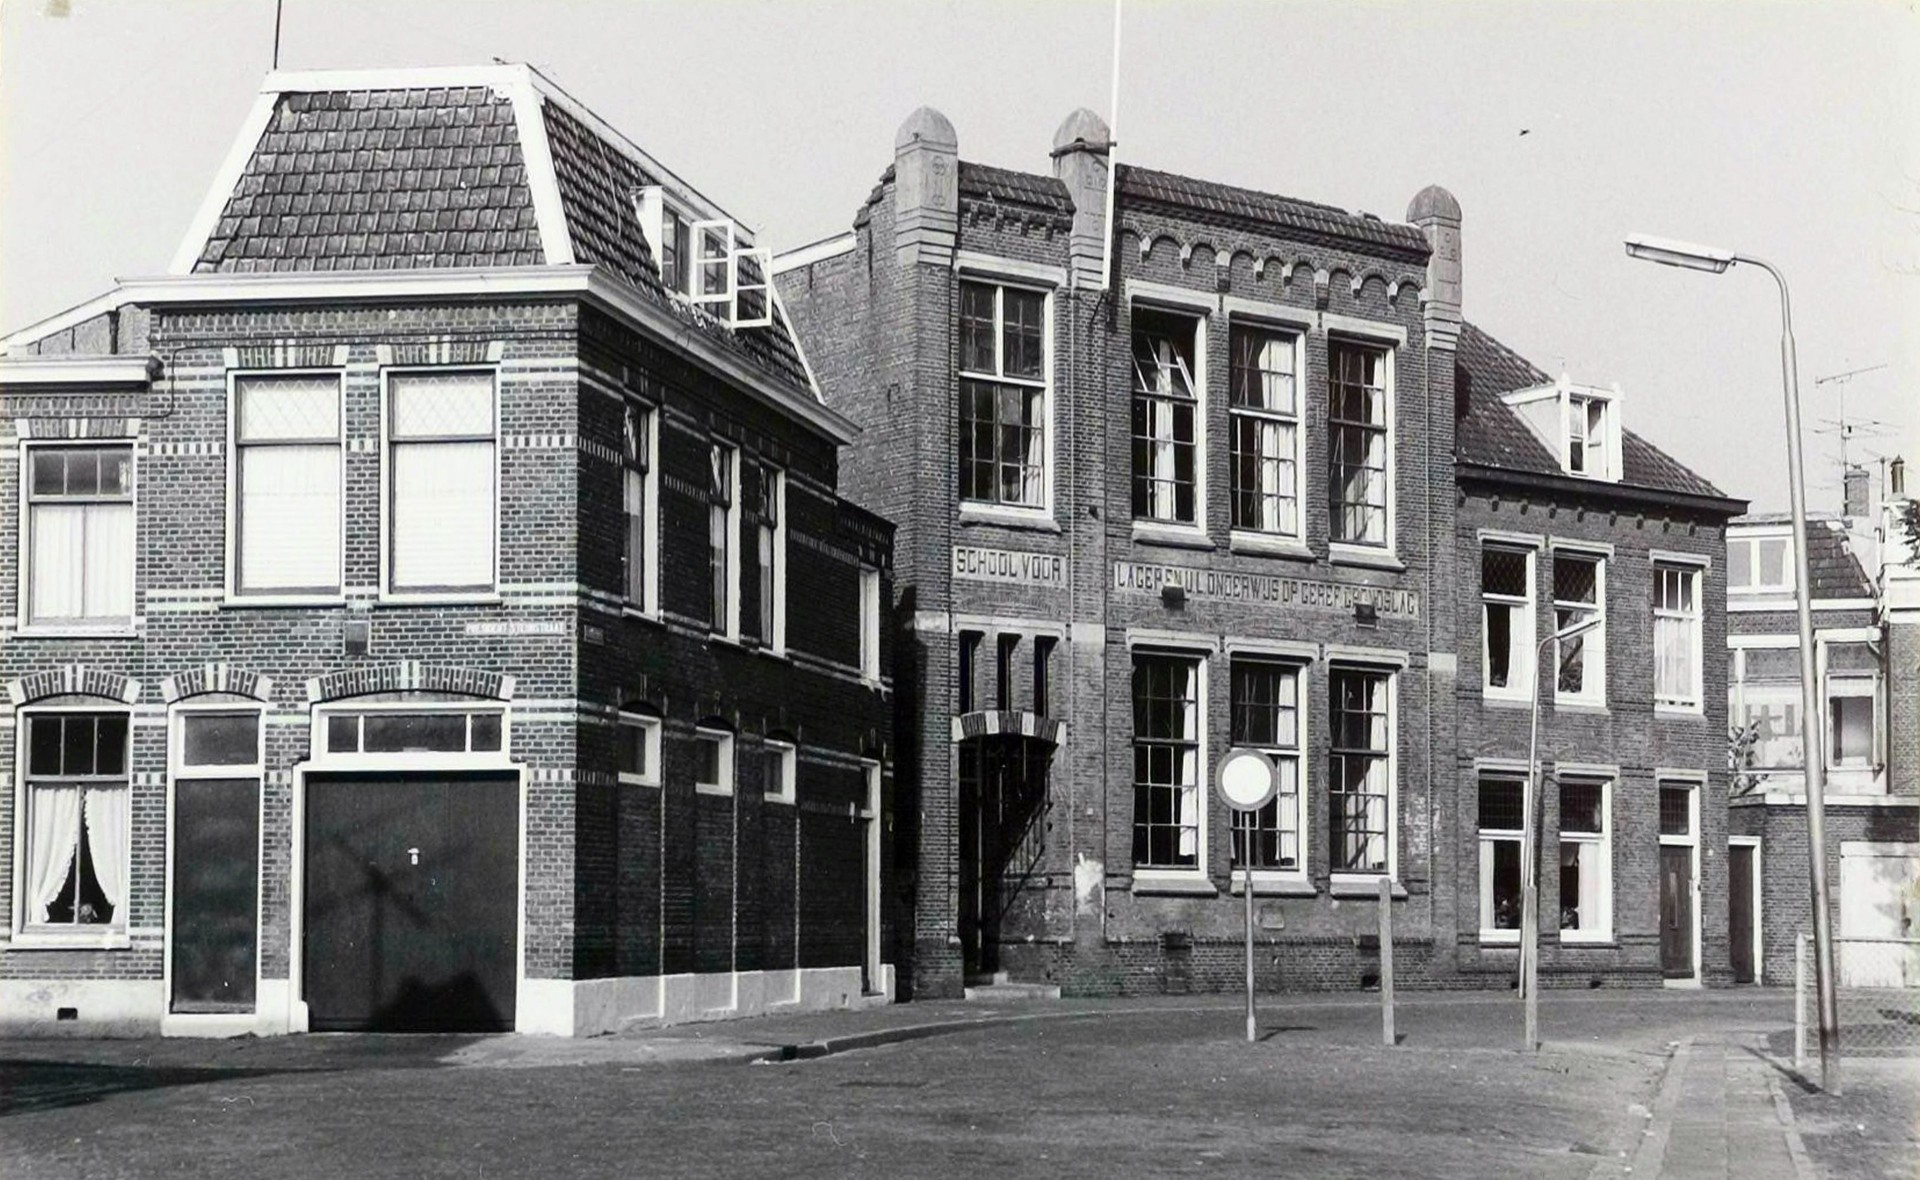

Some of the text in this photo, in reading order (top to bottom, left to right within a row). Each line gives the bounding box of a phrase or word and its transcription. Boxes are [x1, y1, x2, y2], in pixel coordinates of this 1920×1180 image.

[957, 549, 1060, 581] SCHOOL VOOR
[1117, 563, 1162, 590] LAGER
[1207, 572, 1279, 601] ONDERWIJS
[1282, 580, 1298, 603] OP
